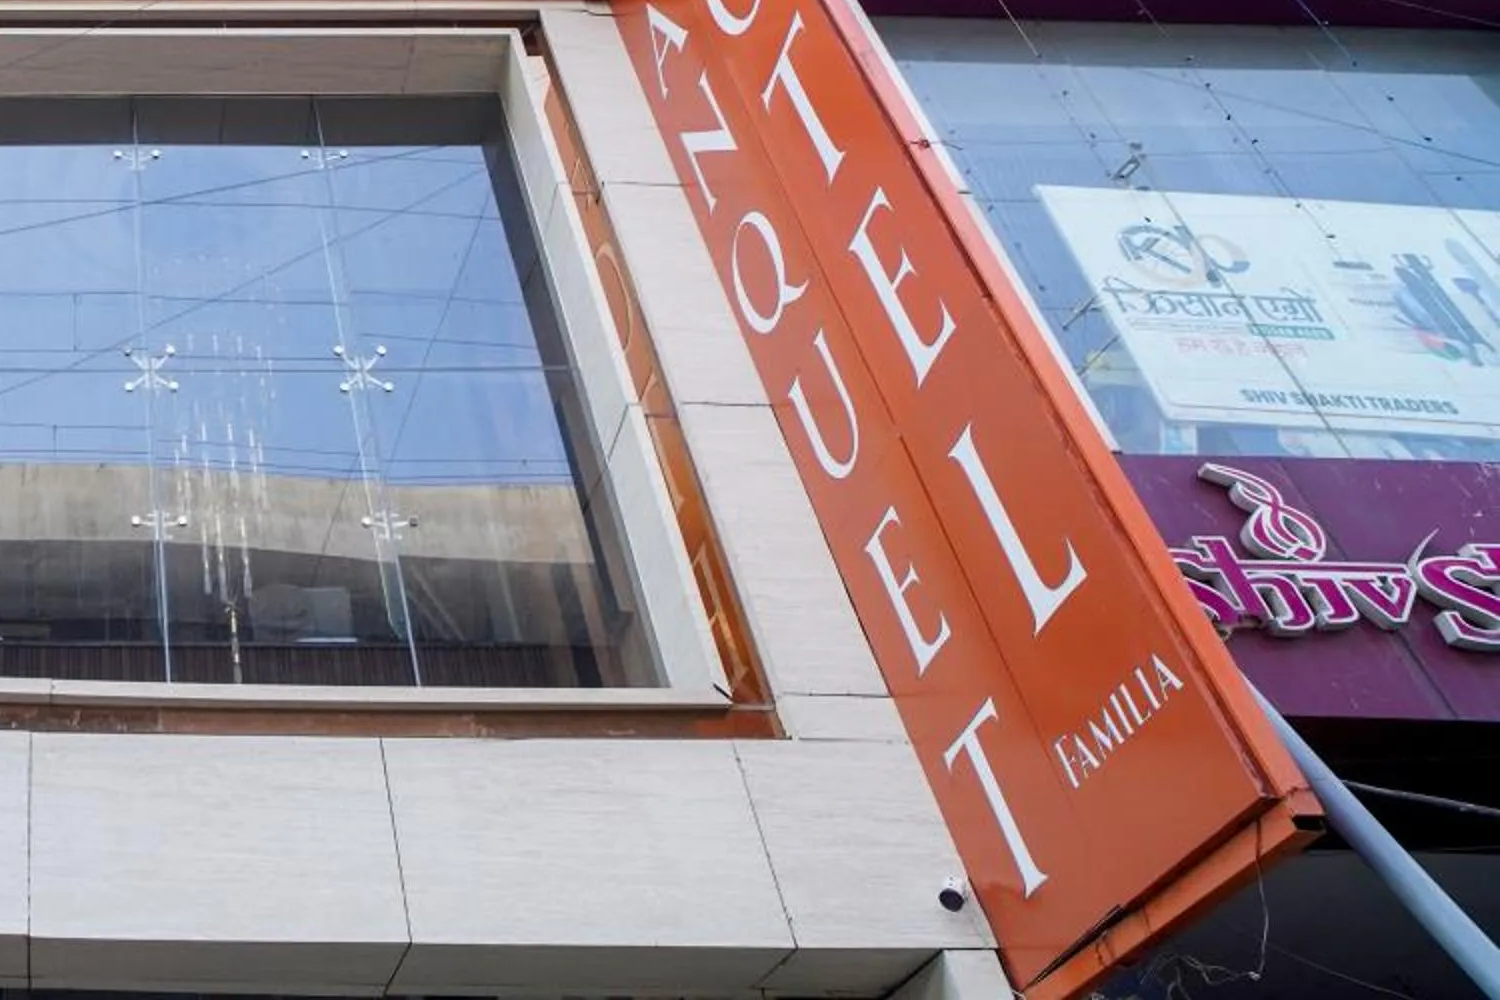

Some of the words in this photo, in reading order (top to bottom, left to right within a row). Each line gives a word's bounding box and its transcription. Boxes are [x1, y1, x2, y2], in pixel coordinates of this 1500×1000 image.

[1239, 388, 1288, 405] SHIV
[1365, 395, 1460, 415] TRADERS
[1053, 651, 1185, 790] FAMILIA
